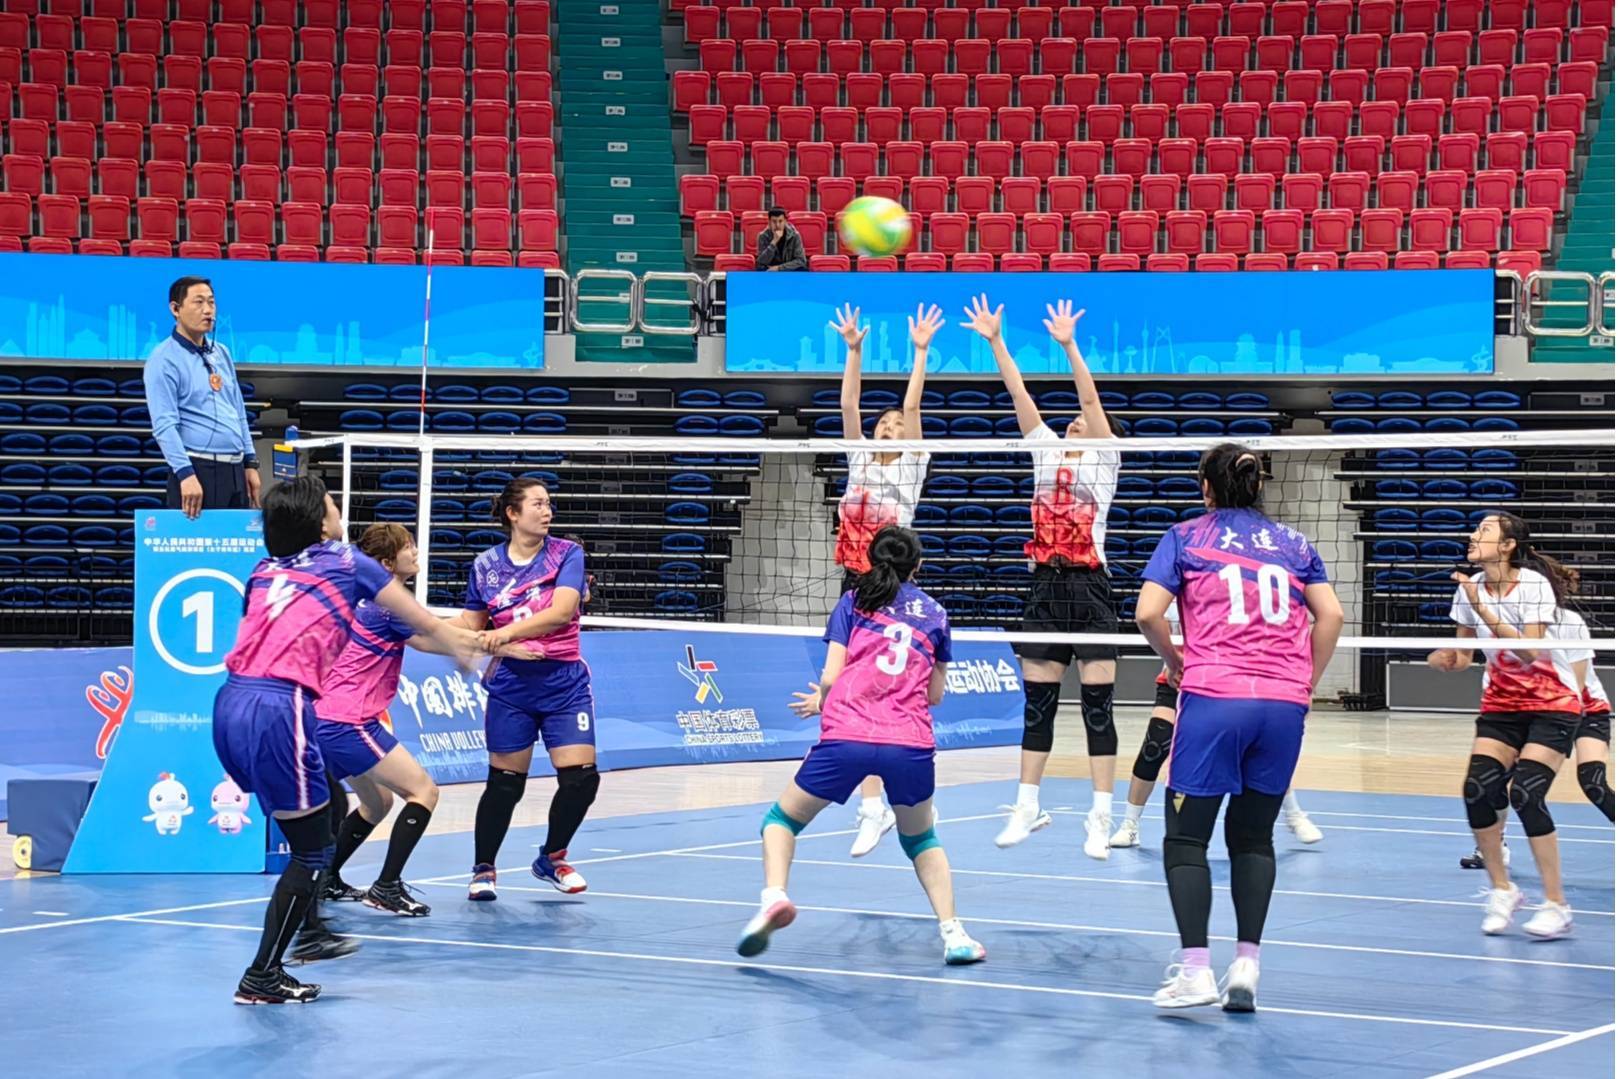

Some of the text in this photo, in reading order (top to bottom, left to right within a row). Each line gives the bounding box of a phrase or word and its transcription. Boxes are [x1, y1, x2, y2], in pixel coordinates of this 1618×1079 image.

[1218, 563, 1290, 625] 10
[182, 591, 214, 653] 1
[876, 622, 912, 676] 3
[577, 711, 589, 731] 9
[675, 708, 760, 733] 中国体育彩票
[420, 732, 454, 752] CHINA
[684, 734, 707, 745] CHINA
